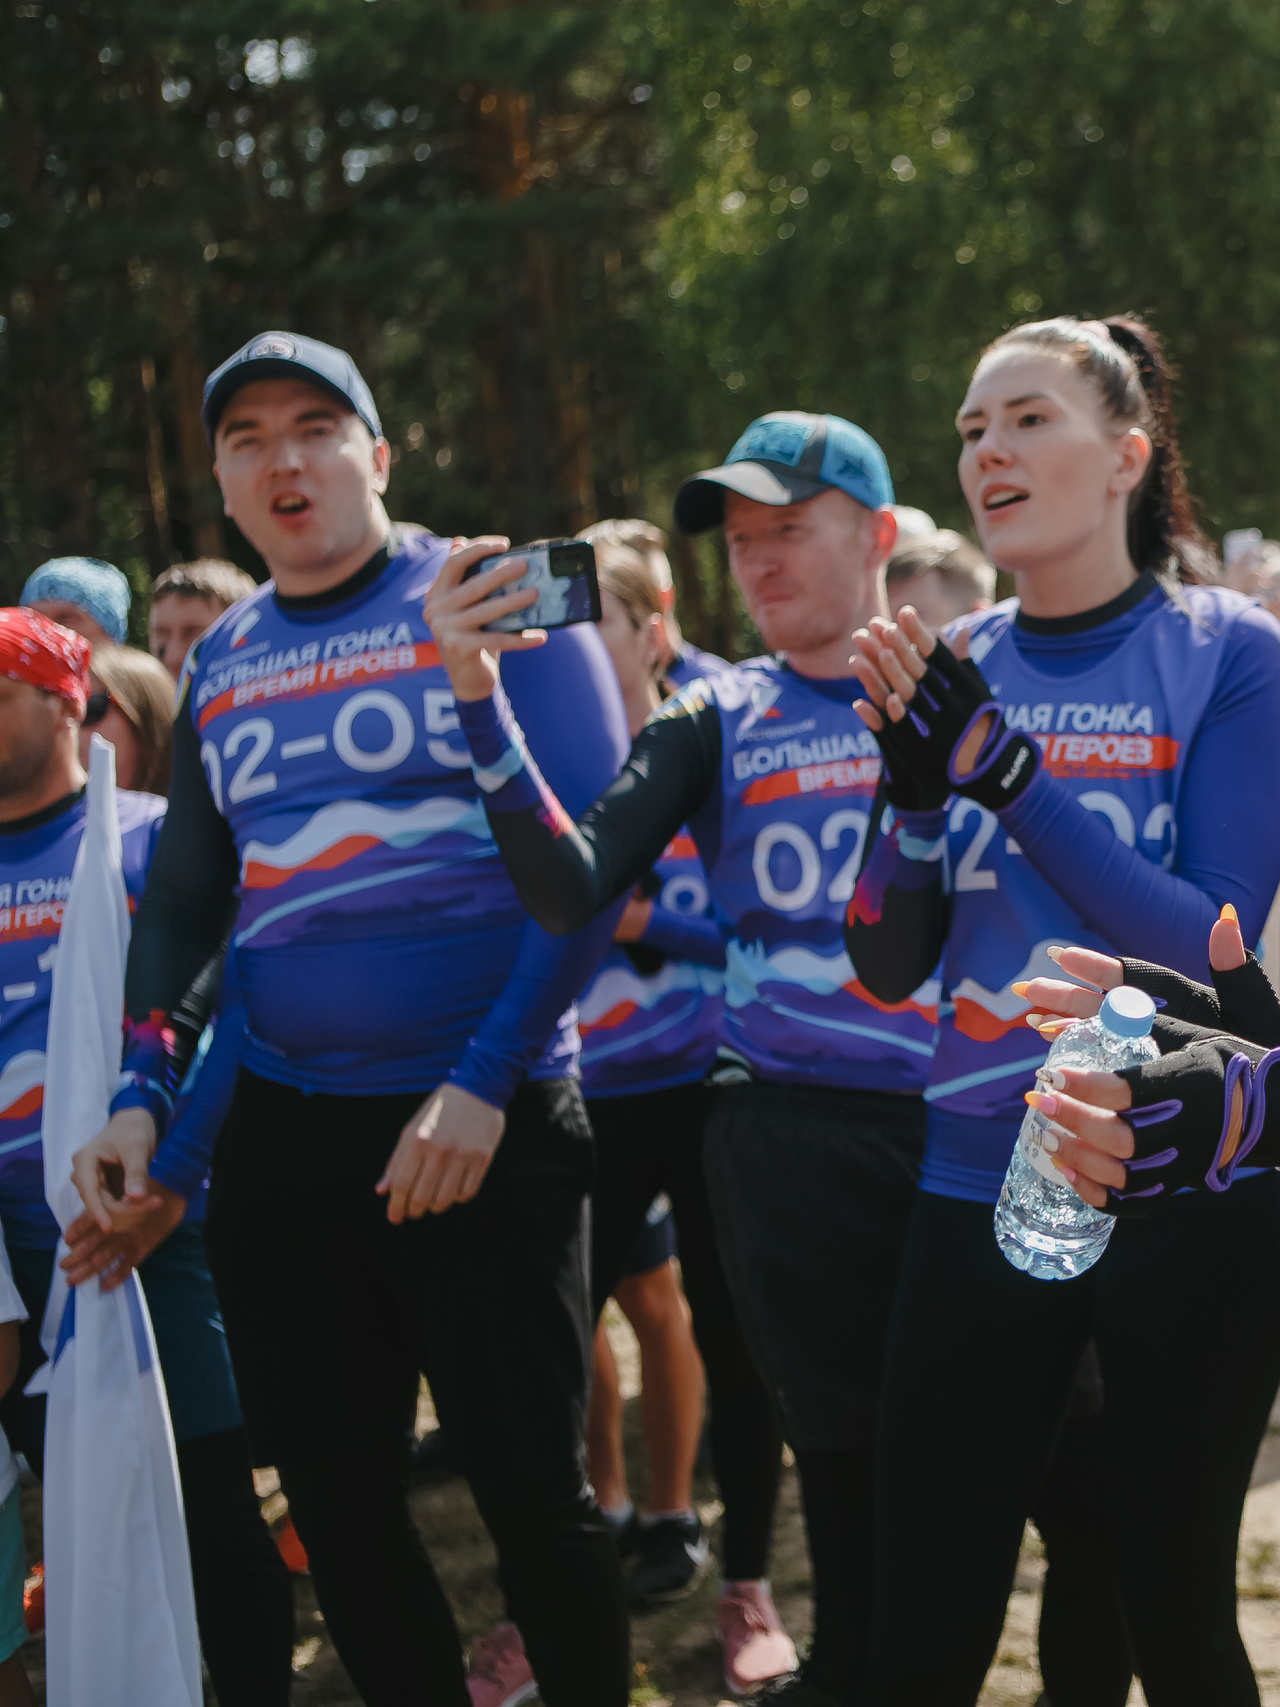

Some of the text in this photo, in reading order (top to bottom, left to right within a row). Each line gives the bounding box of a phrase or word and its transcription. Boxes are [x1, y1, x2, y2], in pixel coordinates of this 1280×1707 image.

[196, 640, 320, 708] БОЛЬШАЯ
[321, 621, 414, 662] ГОНКА
[231, 663, 318, 708] ВРЕМЯ
[318, 643, 417, 684] ГЕРОЕВ
[1055, 701, 1155, 735] ГОНКА
[732, 730, 882, 781] БОЛЬШАЯ
